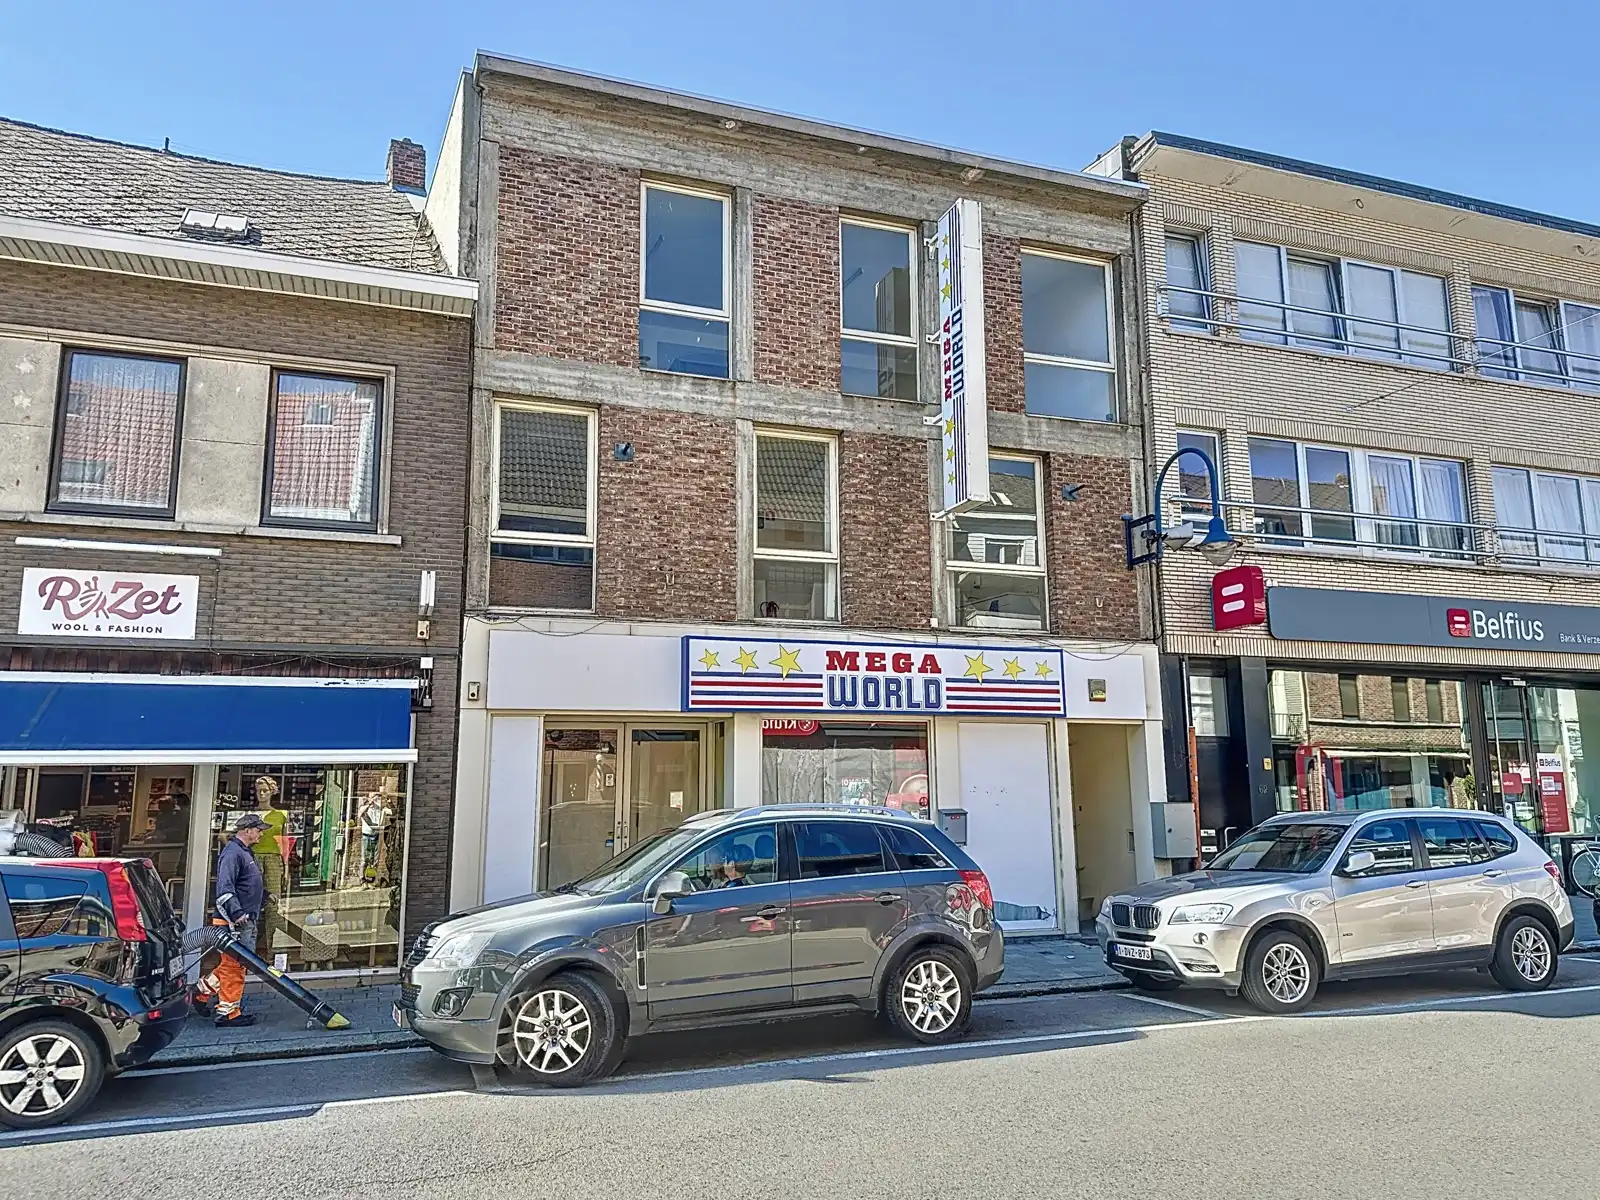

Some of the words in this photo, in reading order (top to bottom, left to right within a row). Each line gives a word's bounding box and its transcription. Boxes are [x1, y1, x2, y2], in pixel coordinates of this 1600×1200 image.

[943, 316, 952, 402] MEGA
[951, 308, 964, 394] WORLD
[51, 623, 89, 632] WOOL
[108, 625, 163, 634] FASHION
[1472, 609, 1545, 641] Belfius
[1560, 633, 1576, 643] Bank
[1576, 634, 1582, 643] &
[825, 650, 942, 674] MEGA
[827, 674, 943, 711] WORLD
[1544, 758, 1561, 767] Belfius
